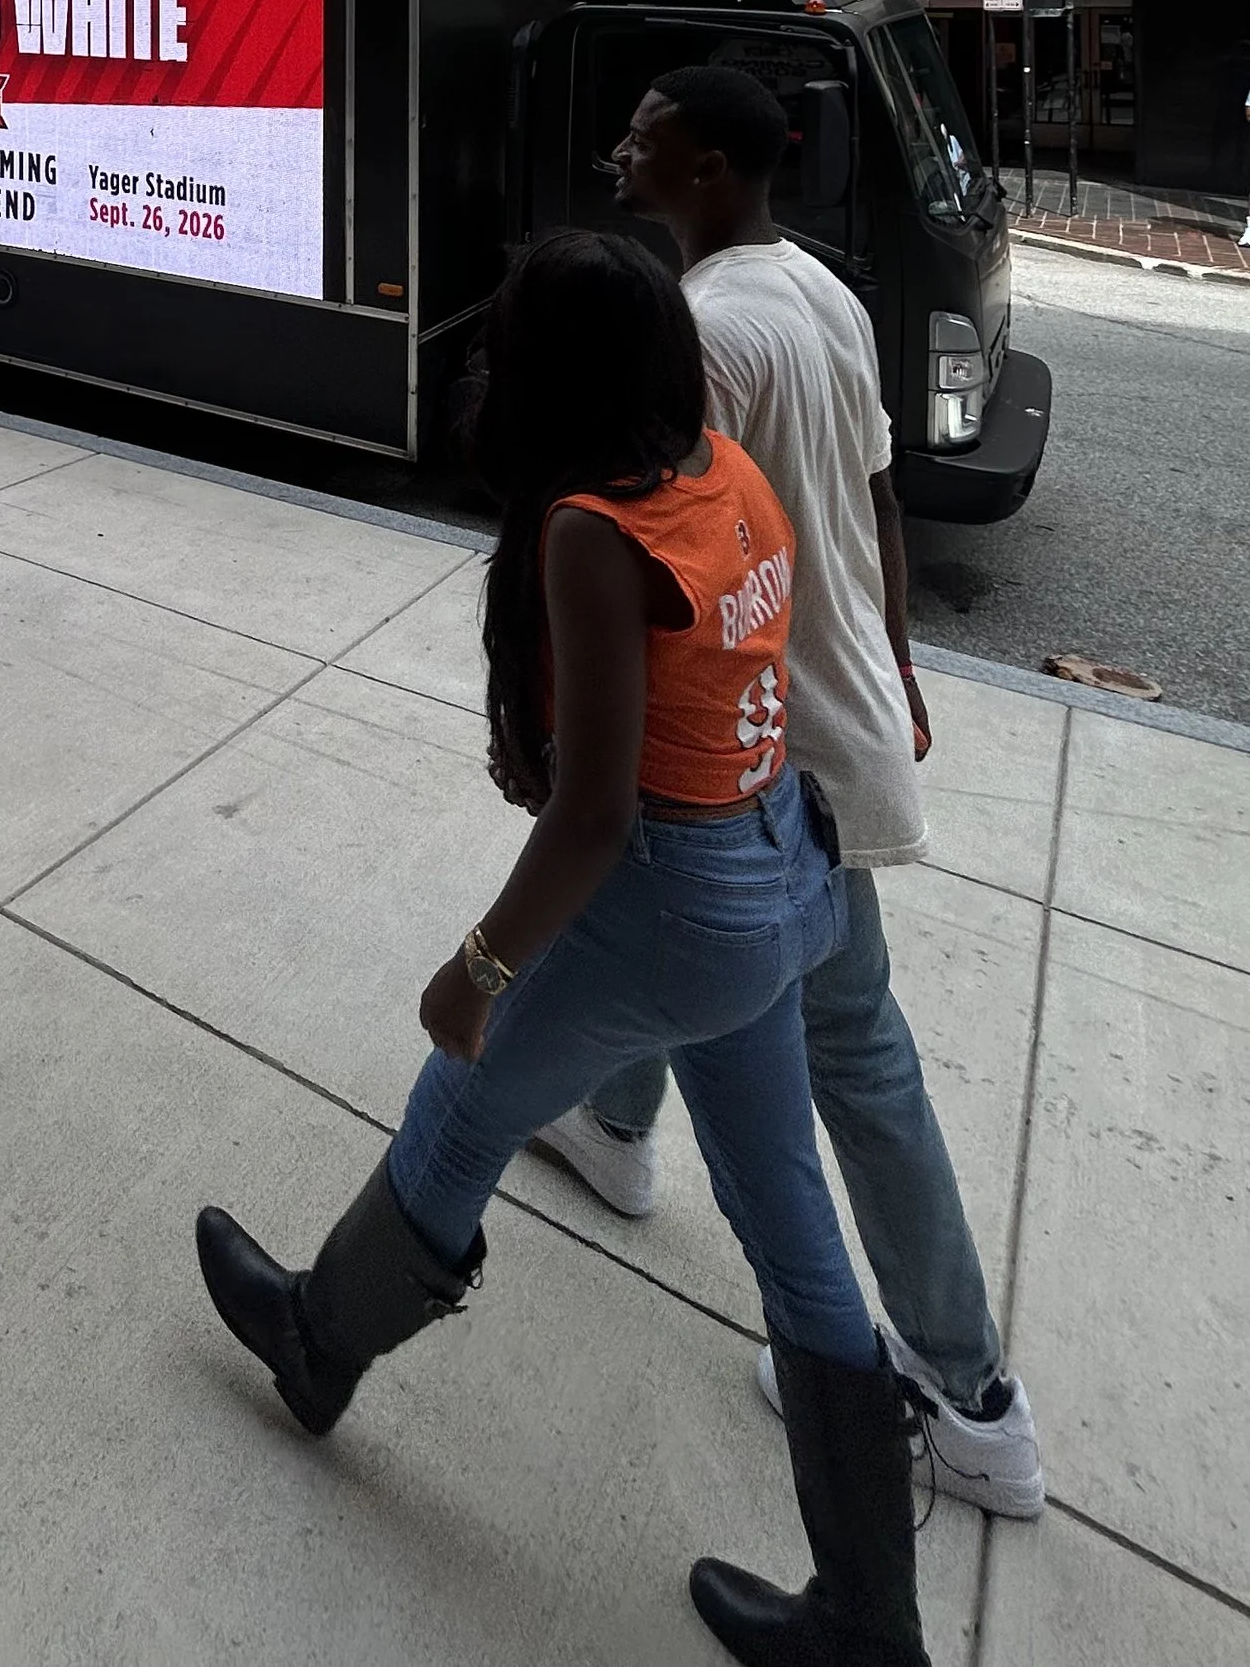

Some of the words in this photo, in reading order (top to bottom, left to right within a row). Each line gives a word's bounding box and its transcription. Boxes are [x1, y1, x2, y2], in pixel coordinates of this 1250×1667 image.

[88, 164, 139, 196] Yager
[145, 172, 226, 206] Stadium
[89, 197, 135, 228] Sept.
[142, 204, 170, 238] 26,
[178, 209, 225, 240] 2026
